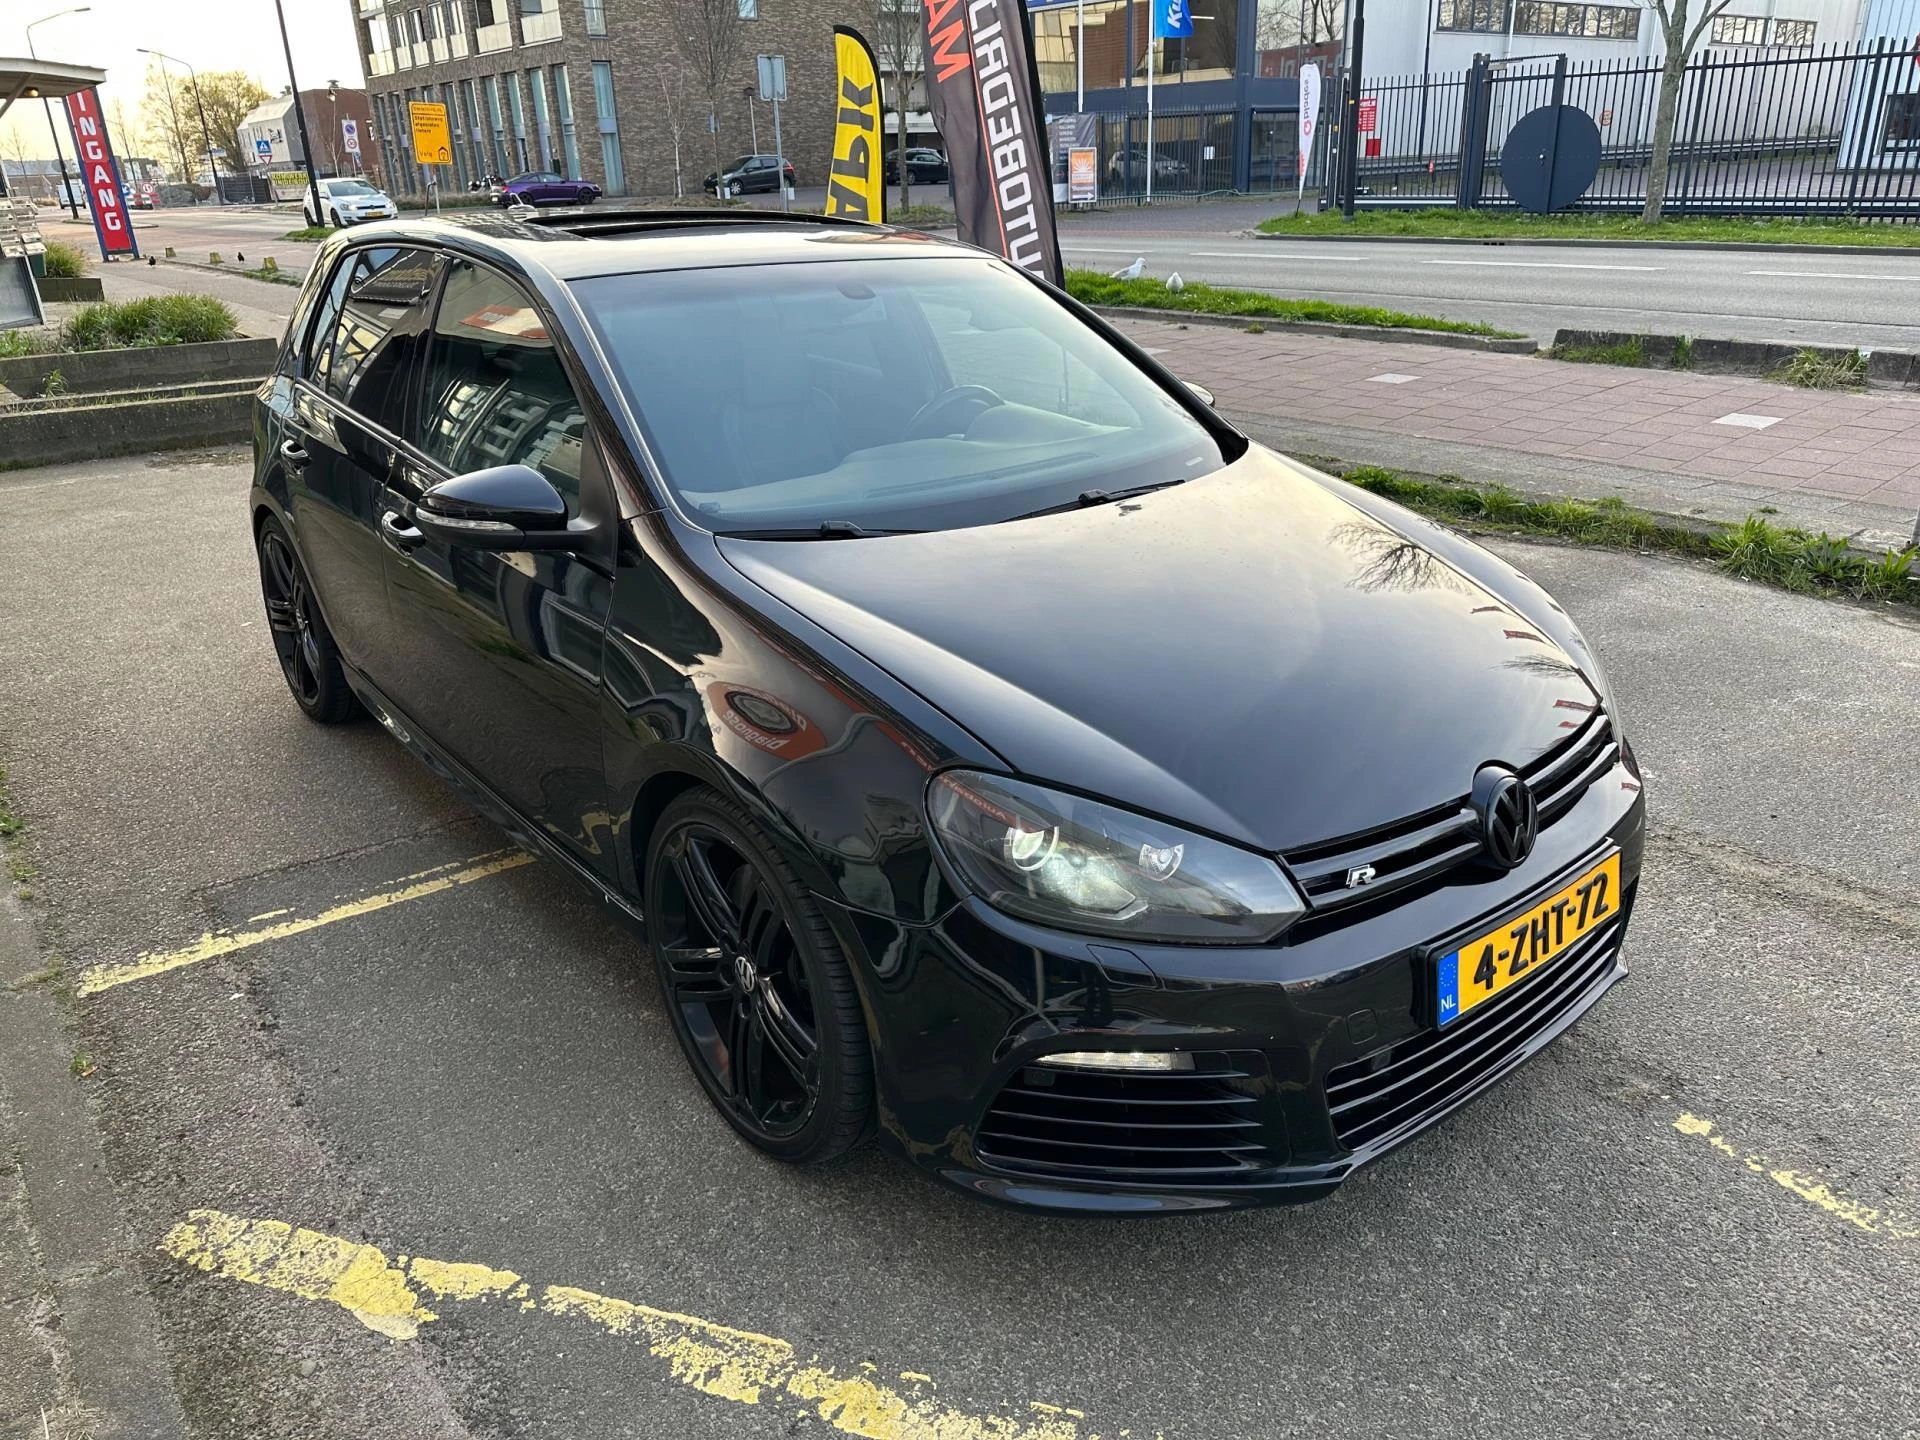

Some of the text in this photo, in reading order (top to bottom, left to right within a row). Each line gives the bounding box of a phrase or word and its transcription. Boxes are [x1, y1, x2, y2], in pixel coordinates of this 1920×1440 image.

[76, 91, 122, 232] INGANG
[1345, 863, 1376, 889] R
[1473, 871, 1609, 990] 4-ZHT-72
[1441, 994, 1456, 1013] NL
